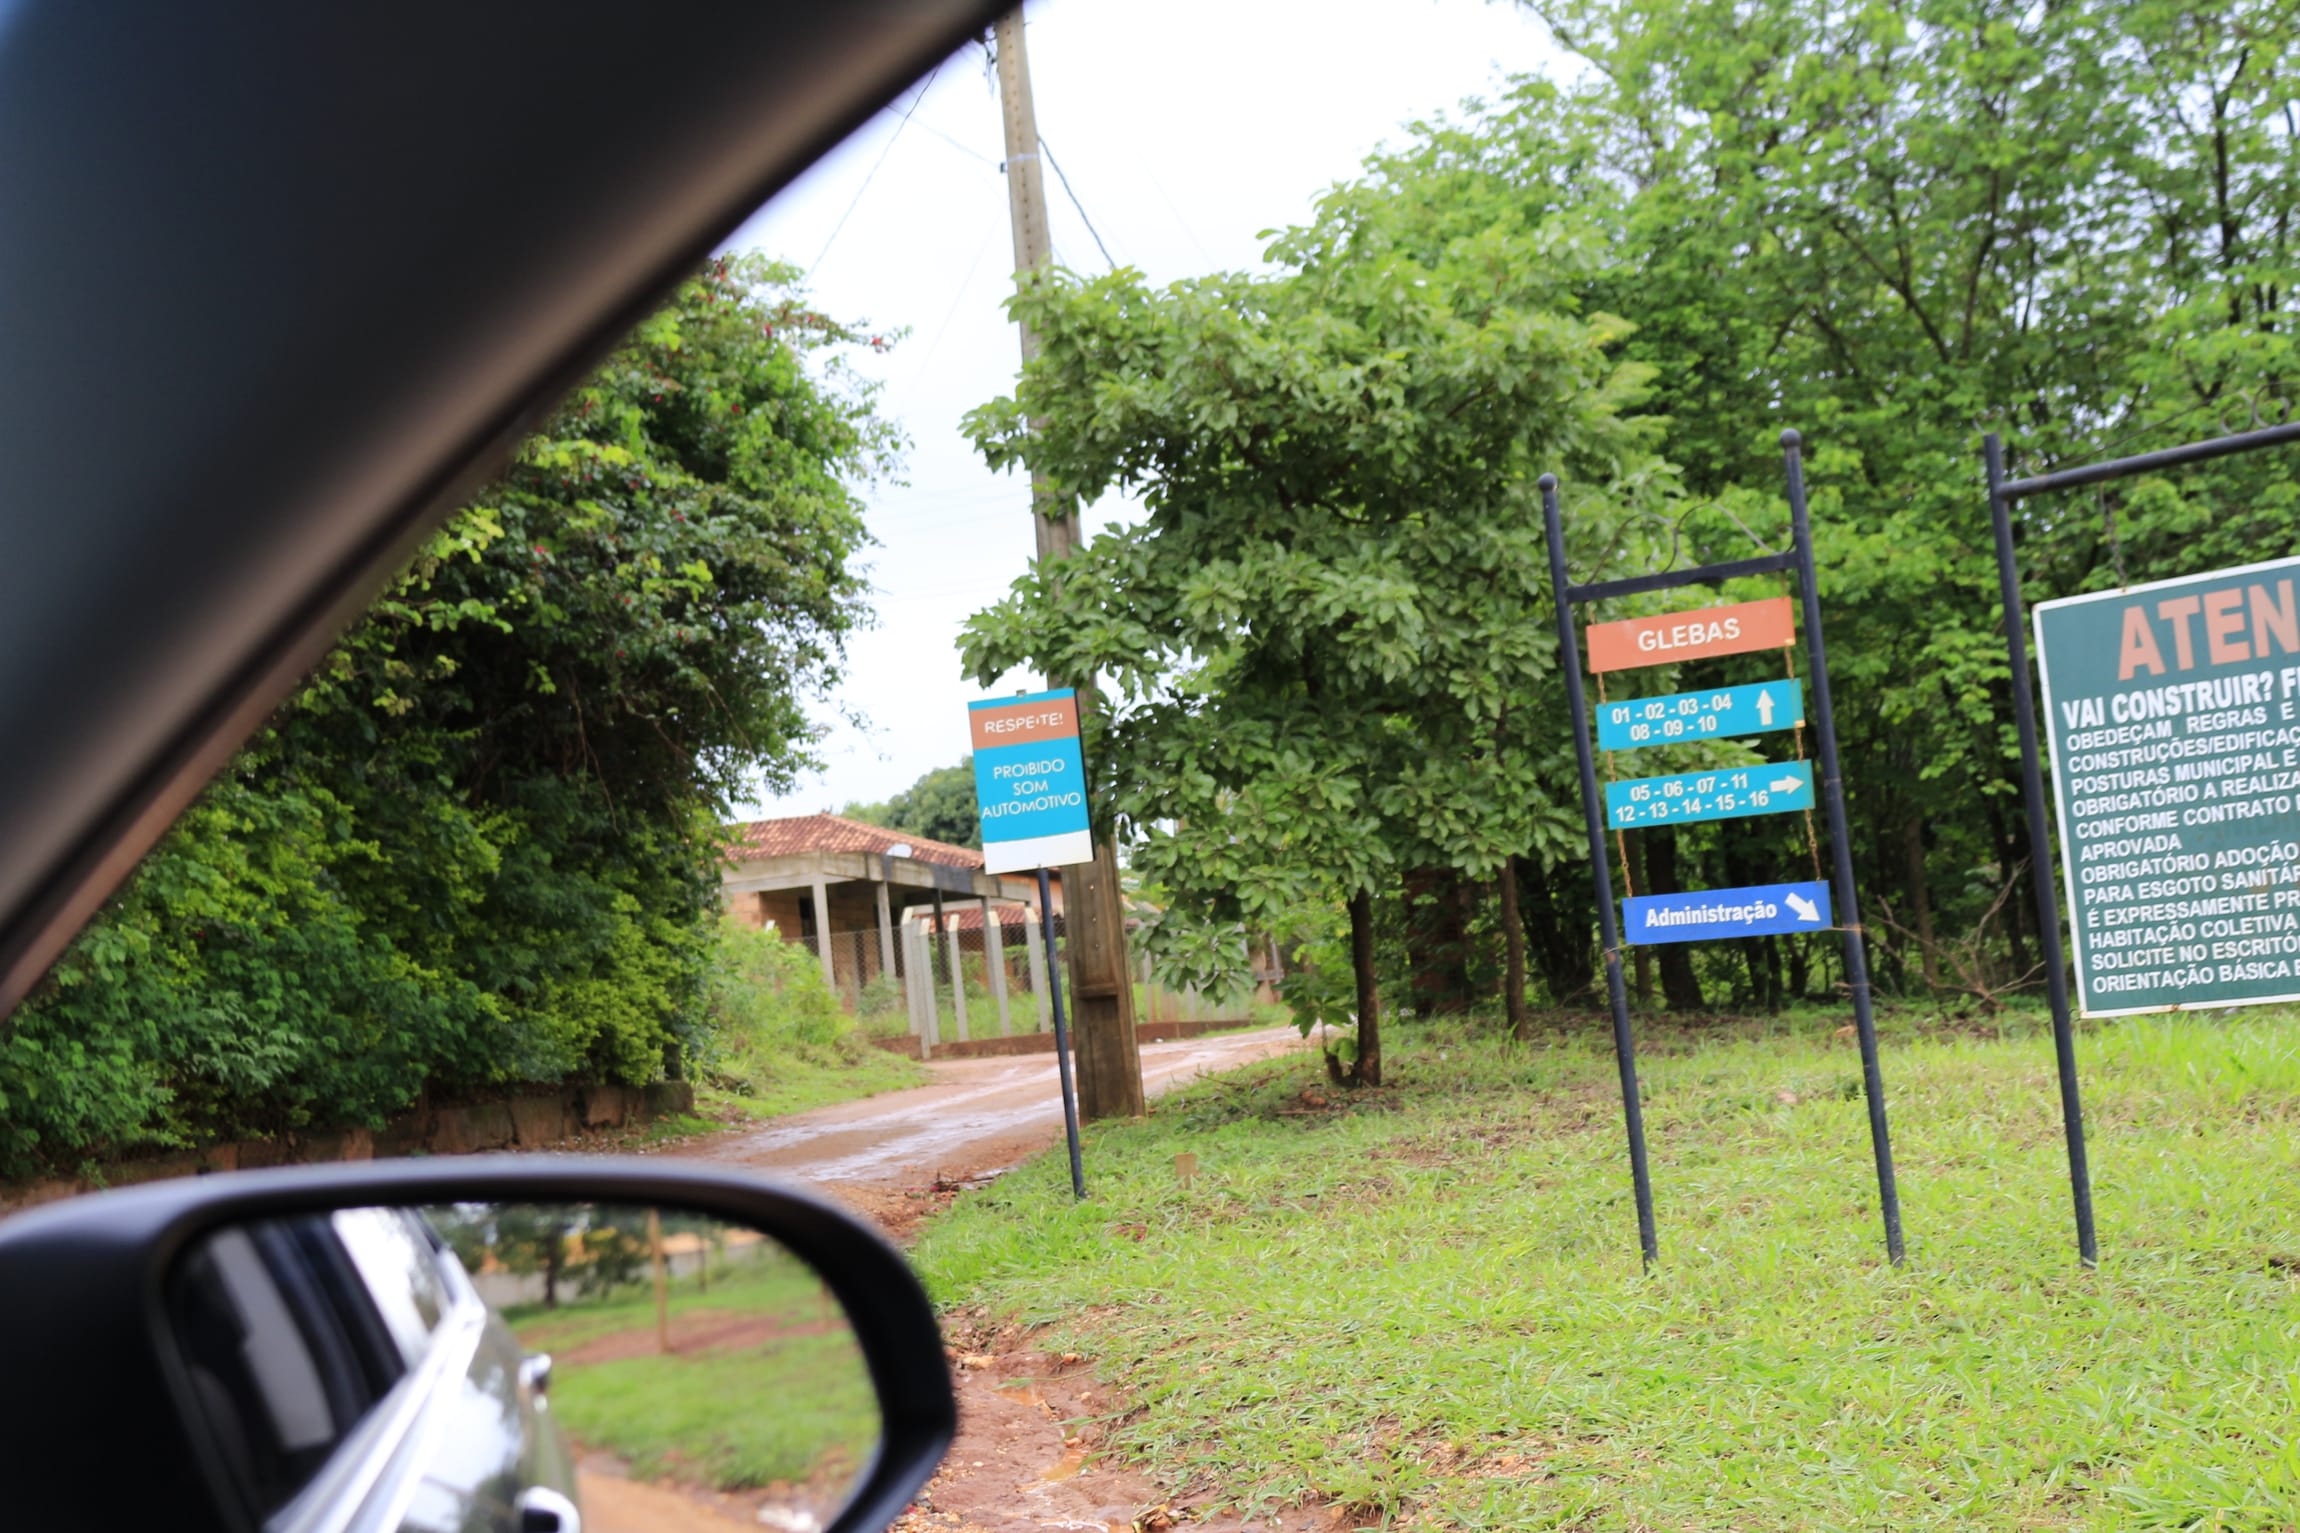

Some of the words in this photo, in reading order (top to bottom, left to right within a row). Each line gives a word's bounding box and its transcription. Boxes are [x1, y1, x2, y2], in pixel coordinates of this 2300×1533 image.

[1638, 618, 1741, 652] GLEBAS
[2118, 579, 2300, 681] ATEN
[1612, 703, 1630, 723] 01
[1645, 701, 1665, 720] 02
[1679, 698, 1699, 715] 03
[1712, 694, 1732, 712] 04
[2062, 697, 2104, 729] VAI
[2112, 671, 2274, 723] CONSTRUIR?
[2280, 666, 2300, 699] F
[984, 713, 1063, 733] RESPEITE!
[1630, 724, 1650, 742] 08
[1664, 719, 1683, 738] 09
[1698, 715, 1716, 733] 10
[2067, 720, 2172, 750] OBEDEÇAM
[2187, 706, 2267, 734] REGRAS
[2280, 702, 2295, 720] E
[993, 759, 1065, 779] PROIBIDO
[2071, 765, 2170, 795] POSTURAS
[2175, 751, 2280, 782] MUNICIPAL
[2284, 749, 2297, 766] E
[1013, 780, 1048, 796] SOM
[1630, 783, 1650, 802] 05
[1664, 780, 1683, 798] 06
[1697, 777, 1716, 795] 07
[1730, 773, 1748, 790] 11
[2072, 781, 2199, 817] OBRIGATÓRIO
[2203, 784, 2218, 799] A
[981, 792, 1081, 819] AUTOMOTIVO
[1616, 804, 1635, 823] 12
[1649, 802, 1668, 819] 13
[1682, 797, 1702, 815] 14
[1715, 794, 1735, 812] 15
[1749, 790, 1769, 807] 16
[2076, 811, 2179, 839] CONFORME
[2183, 796, 2291, 825] CONTRATO
[2080, 833, 2182, 862] APROVADA
[2081, 853, 2209, 884] OBRIGATÓRIO
[2214, 839, 2299, 868] ADOÇÃO
[2084, 885, 2135, 905] PARA
[2138, 875, 2217, 899] ESGOTO
[1645, 901, 1777, 927] Administração
[2087, 908, 2100, 928] É
[2104, 892, 2270, 926] EXPRESSAMENTE
[2089, 918, 2196, 949] HABITAÇÃO
[2200, 912, 2298, 939] COLETIVA
[2092, 947, 2176, 971] SOLICITE
[2180, 943, 2207, 962] NO
[2212, 930, 2300, 960] ESCRITÓ
[2092, 964, 2215, 993] ORIENTAÇÃO
[2219, 959, 2291, 982] BÁSICA
